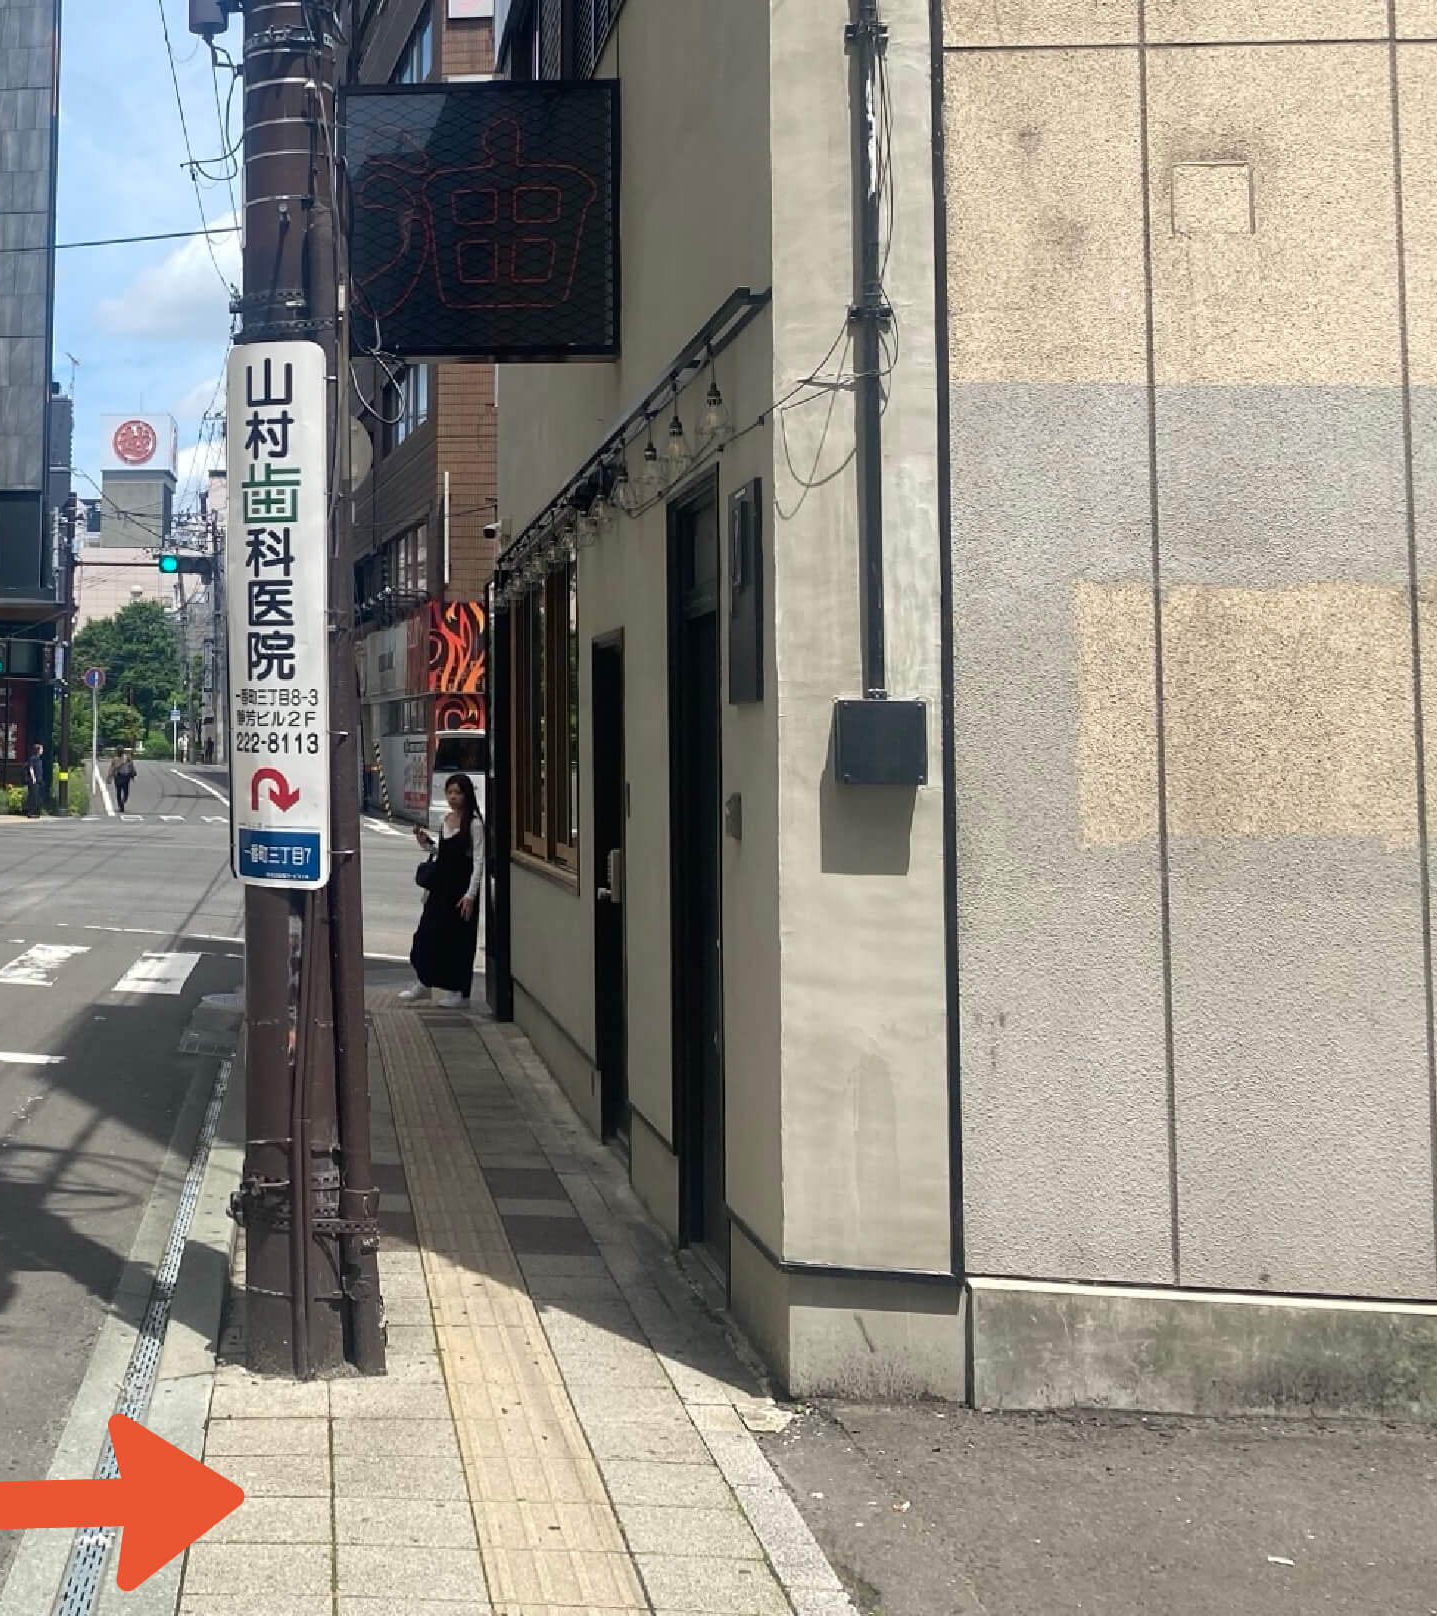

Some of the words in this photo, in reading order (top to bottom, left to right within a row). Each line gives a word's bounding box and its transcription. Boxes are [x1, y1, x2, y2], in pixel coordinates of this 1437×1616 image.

[241, 357, 302, 682] 山村歯科医院
[236, 731, 319, 754] 222-8113
